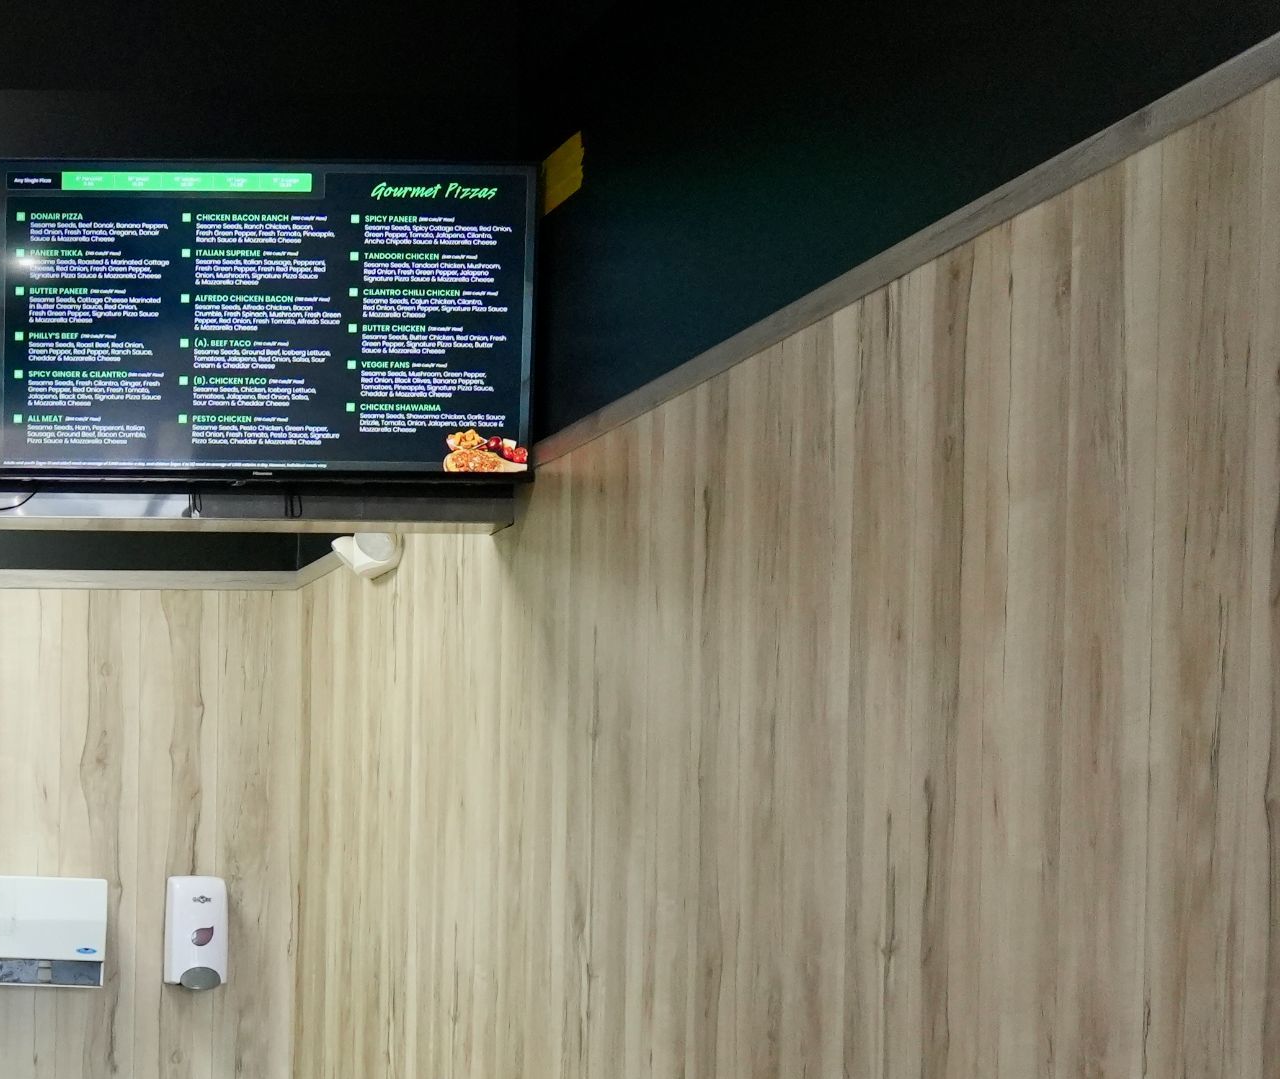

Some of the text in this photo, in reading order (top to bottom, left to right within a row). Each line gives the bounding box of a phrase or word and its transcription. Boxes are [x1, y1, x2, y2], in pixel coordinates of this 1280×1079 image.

[371, 182, 498, 200] Gourmet Pizzas
[365, 215, 387, 223] SPICY
[194, 338, 209, 347] (A).
[209, 377, 244, 385] CHICKEN
